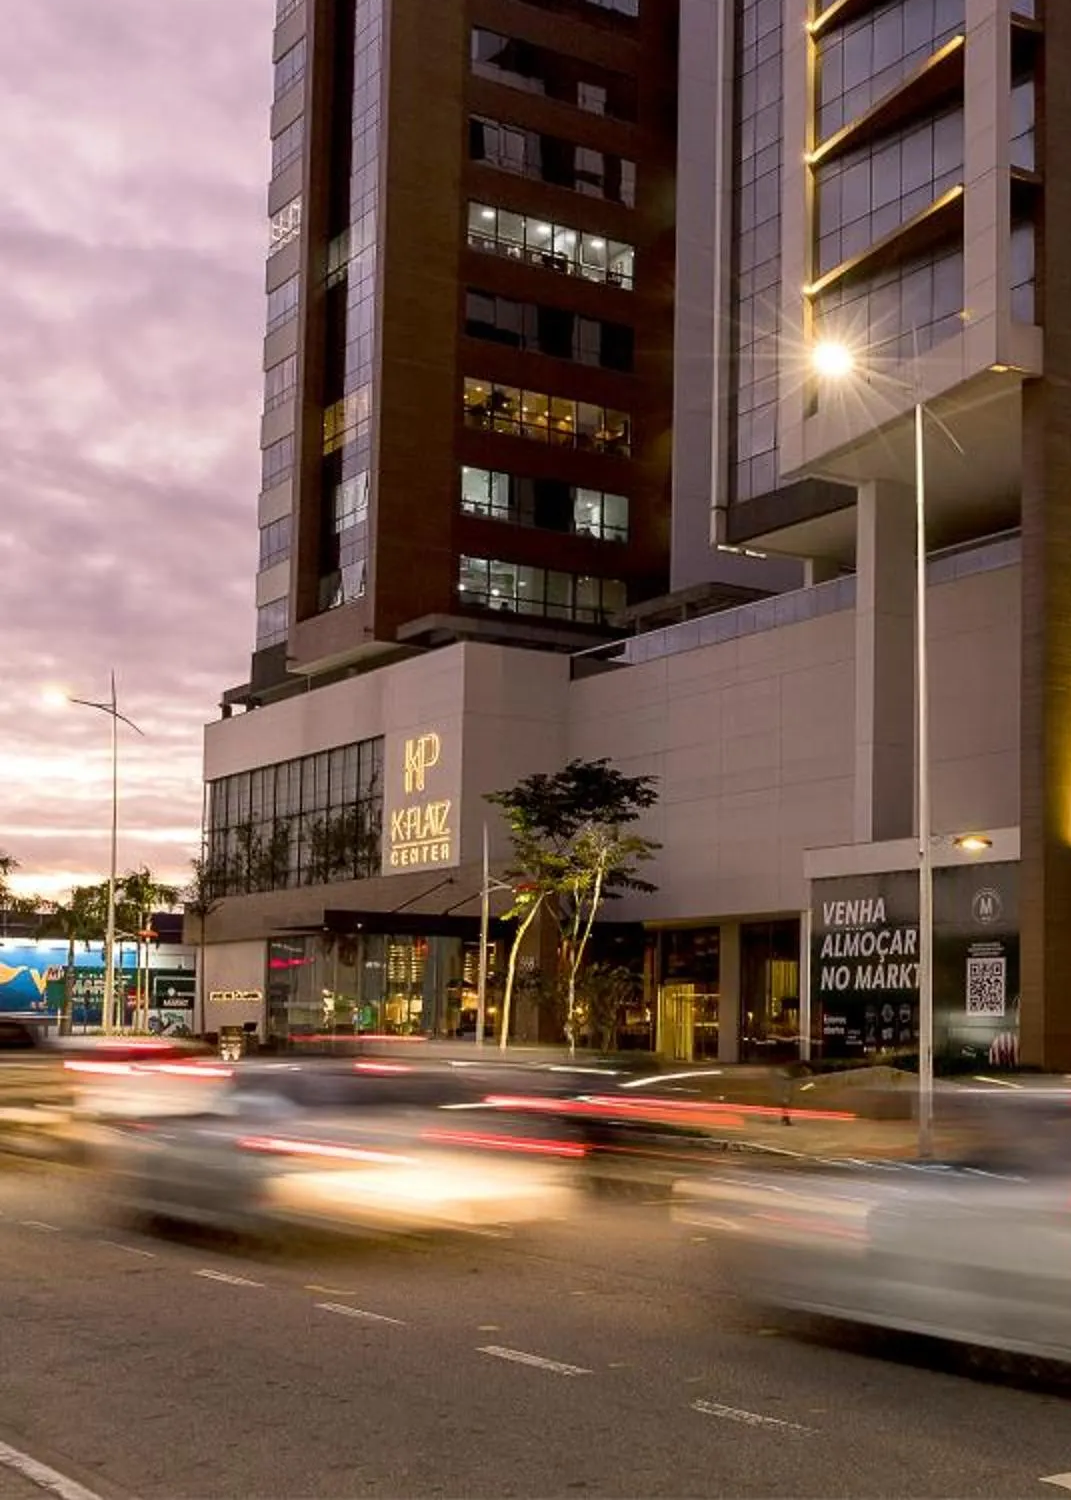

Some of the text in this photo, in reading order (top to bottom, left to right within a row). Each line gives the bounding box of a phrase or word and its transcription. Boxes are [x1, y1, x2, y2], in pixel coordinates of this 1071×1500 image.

[391, 843, 450, 867] CENTER
[823, 897, 887, 926] VENHA
[820, 929, 917, 963] ALMOÇAR
[820, 966, 851, 991] NO
